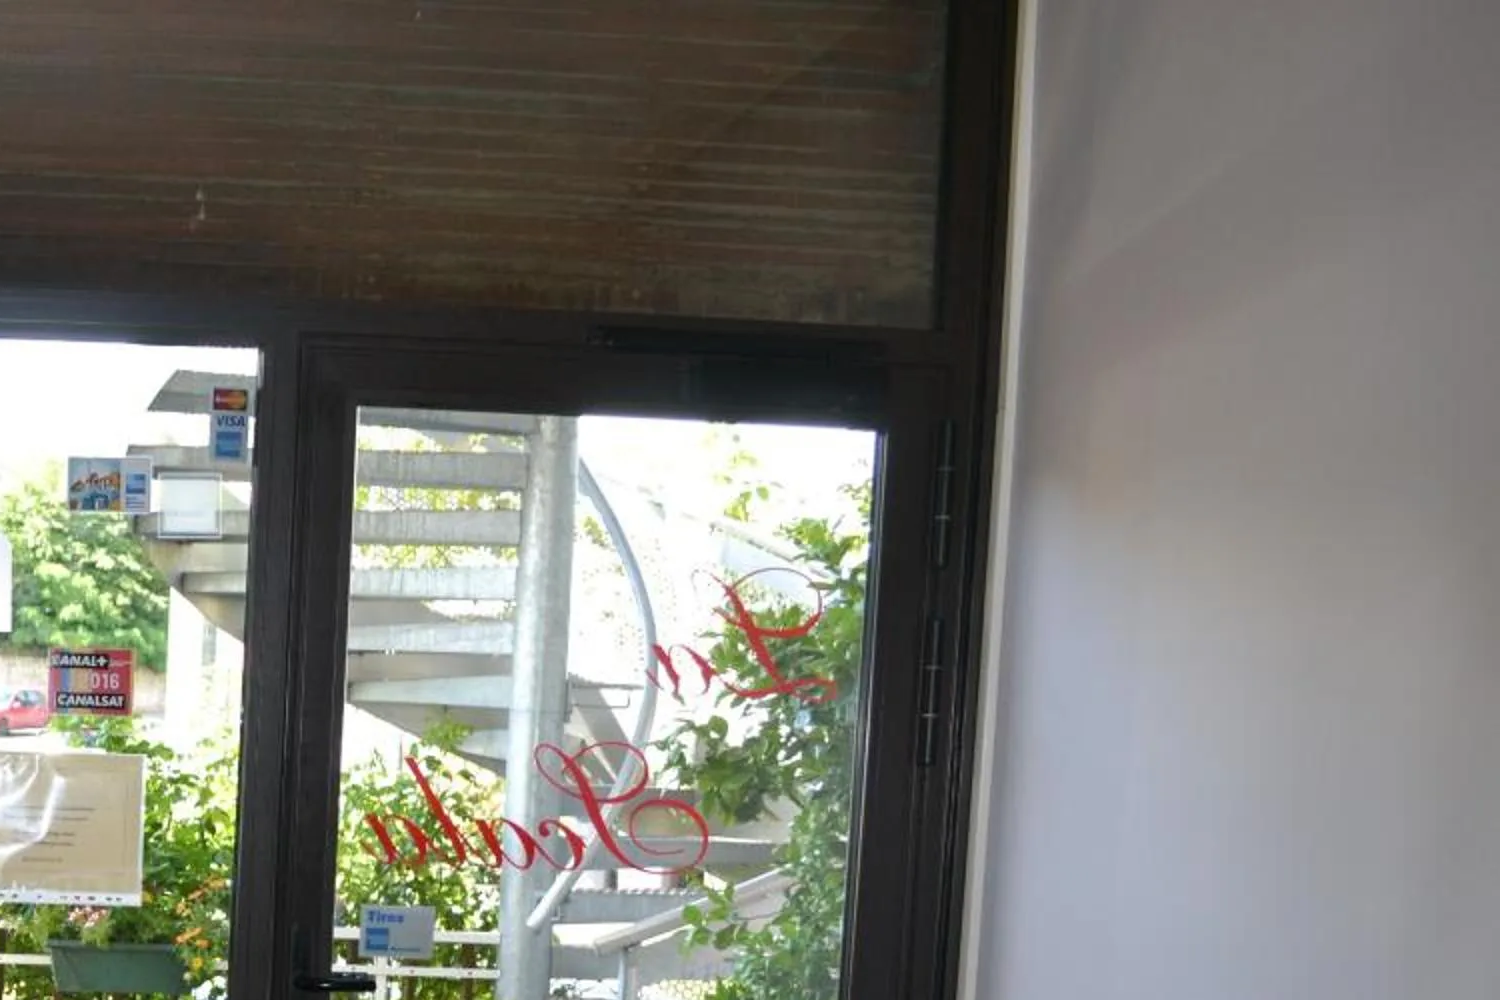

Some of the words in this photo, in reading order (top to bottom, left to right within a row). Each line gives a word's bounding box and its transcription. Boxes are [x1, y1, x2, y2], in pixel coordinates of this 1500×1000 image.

[217, 415, 246, 427] VISA
[90, 671, 121, 691] 016
[57, 693, 124, 708] CANALSAT
